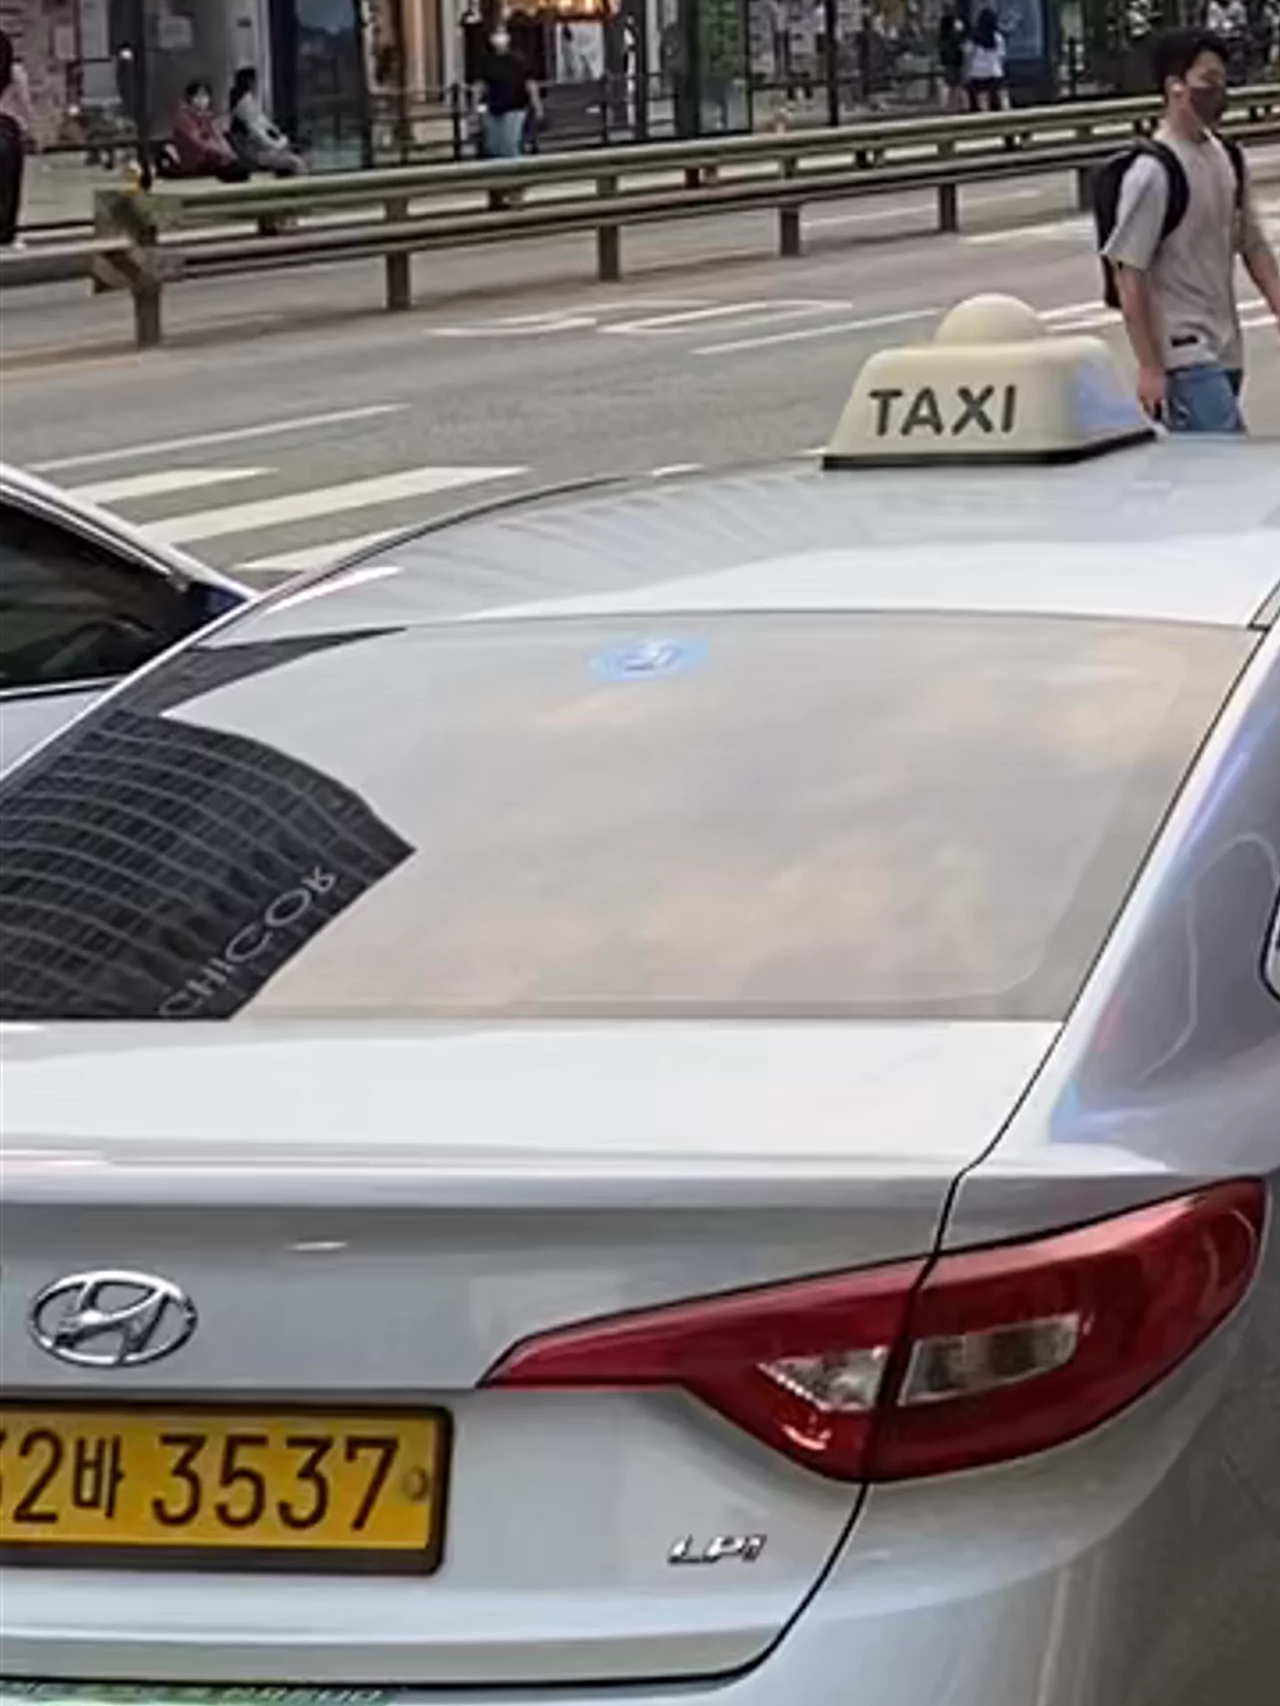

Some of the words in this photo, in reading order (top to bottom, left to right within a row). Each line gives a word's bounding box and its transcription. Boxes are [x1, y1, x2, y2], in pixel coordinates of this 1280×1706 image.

[867, 384, 1018, 437] TAXI
[0, 1429, 126, 1524] 2바
[151, 1434, 399, 1532] 3537
